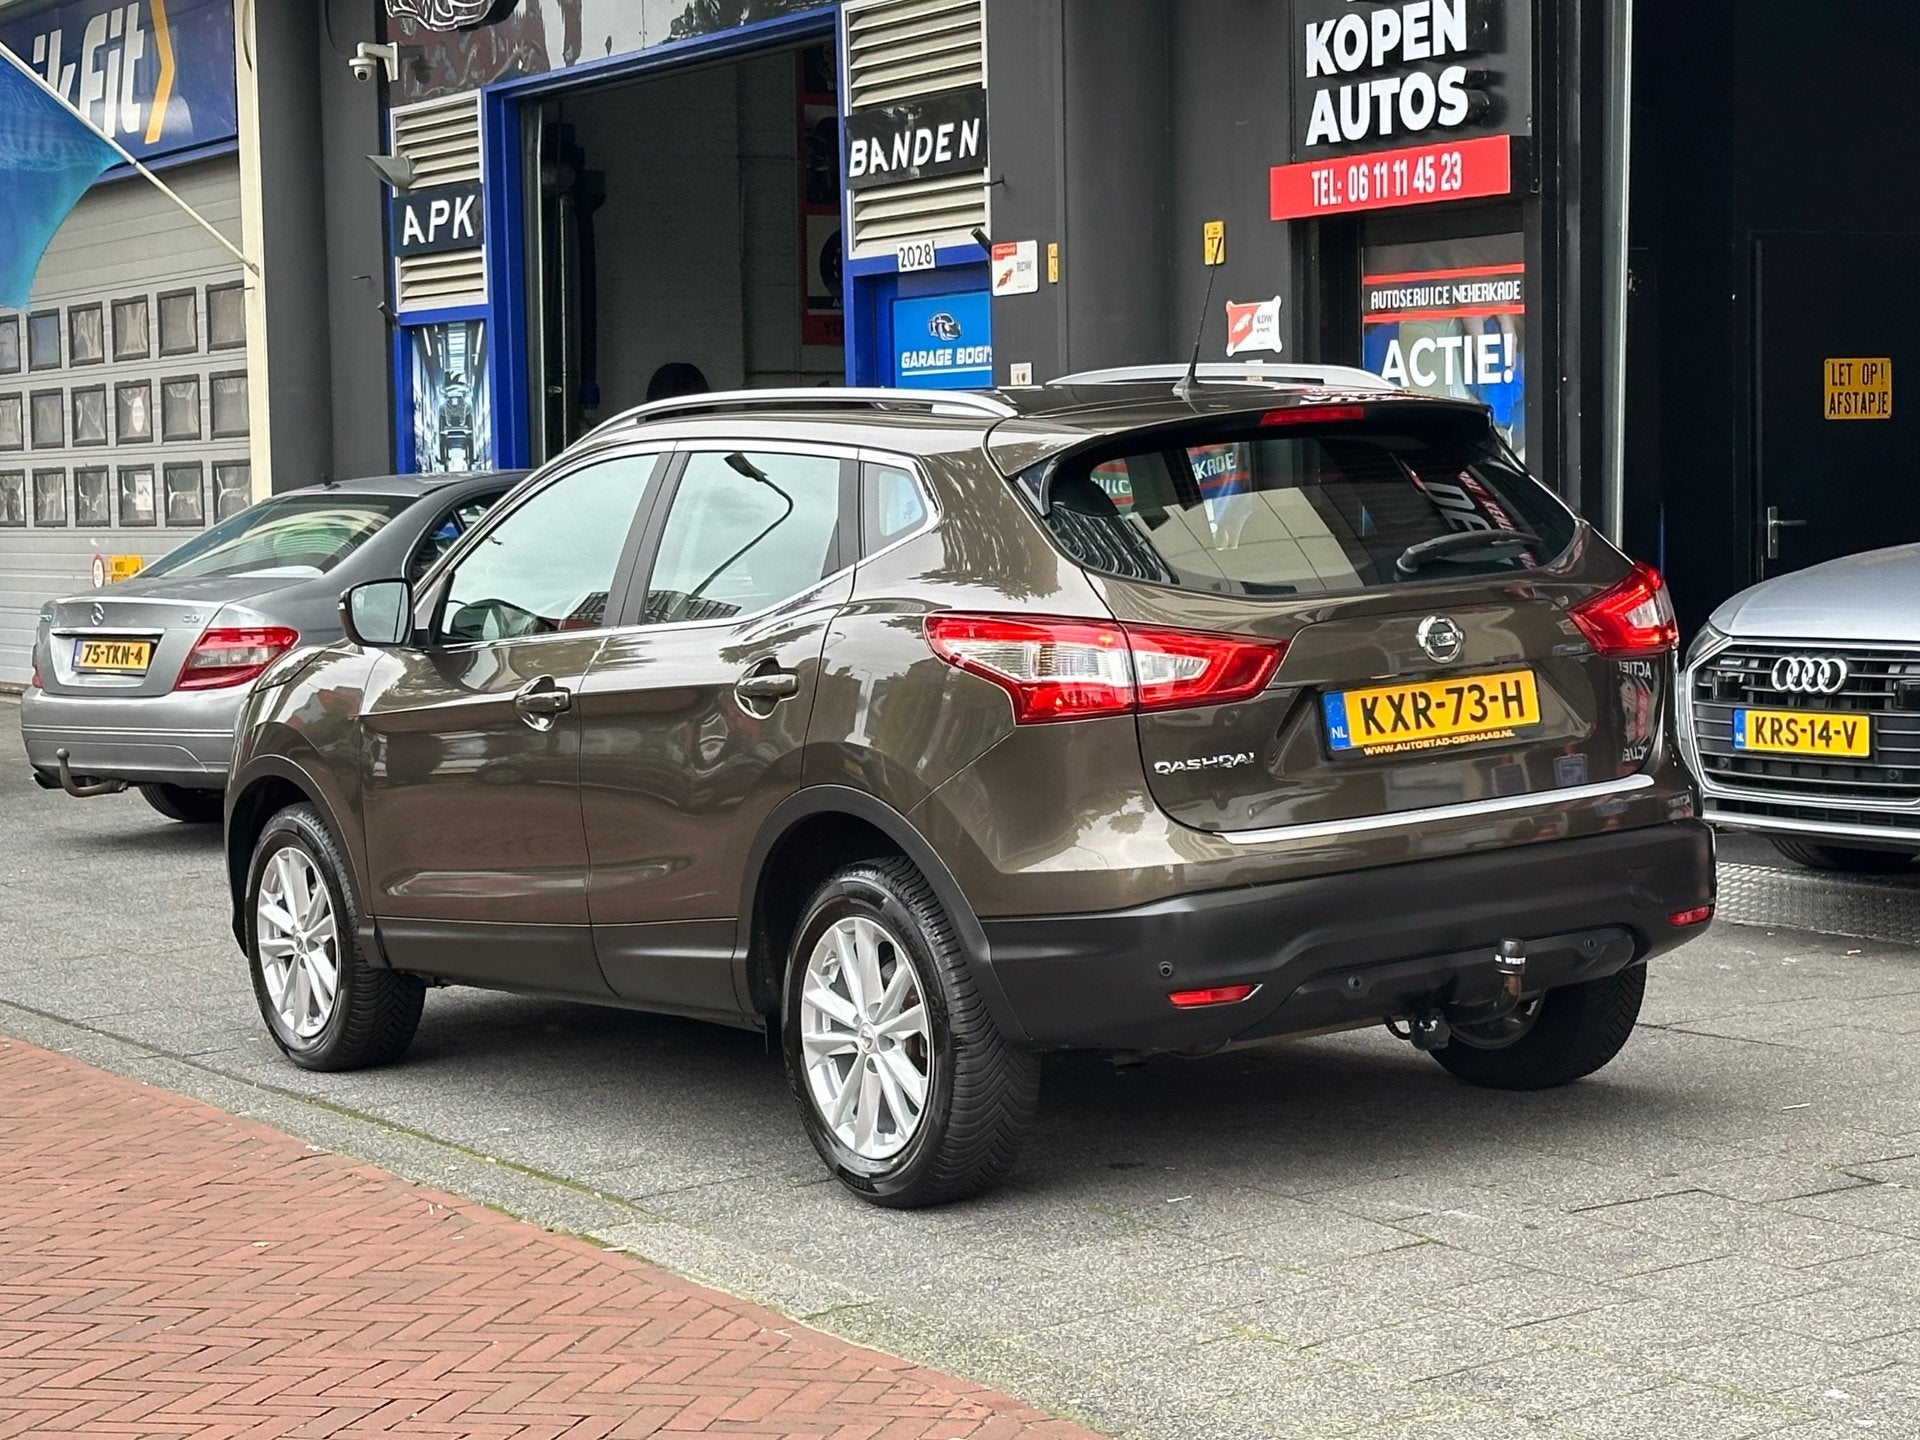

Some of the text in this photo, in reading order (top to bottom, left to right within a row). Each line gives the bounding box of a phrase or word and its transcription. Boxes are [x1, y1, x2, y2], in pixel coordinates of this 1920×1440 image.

[1306, 0, 1467, 78] KOPEN
[1305, 66, 1469, 146] AUTOS
[849, 118, 980, 177] BANDEN
[1311, 151, 1462, 207] TEL: 06 11 11 45 23
[403, 194, 476, 246] APK
[900, 243, 933, 268] 2028
[1452, 280, 1521, 303] NEHERKADE
[901, 349, 953, 369] GARAGE
[1381, 333, 1514, 388] ACTIE!
[1831, 363, 1884, 386] LET OP!
[1829, 392, 1889, 415] AFSTAPJE
[83, 644, 144, 666] 75-TKN-4
[1360, 679, 1525, 736] KXR-73-H
[1331, 727, 1348, 739] NL
[1755, 716, 1857, 749] KRS-14-V
[1154, 752, 1255, 776] QASHQAI
